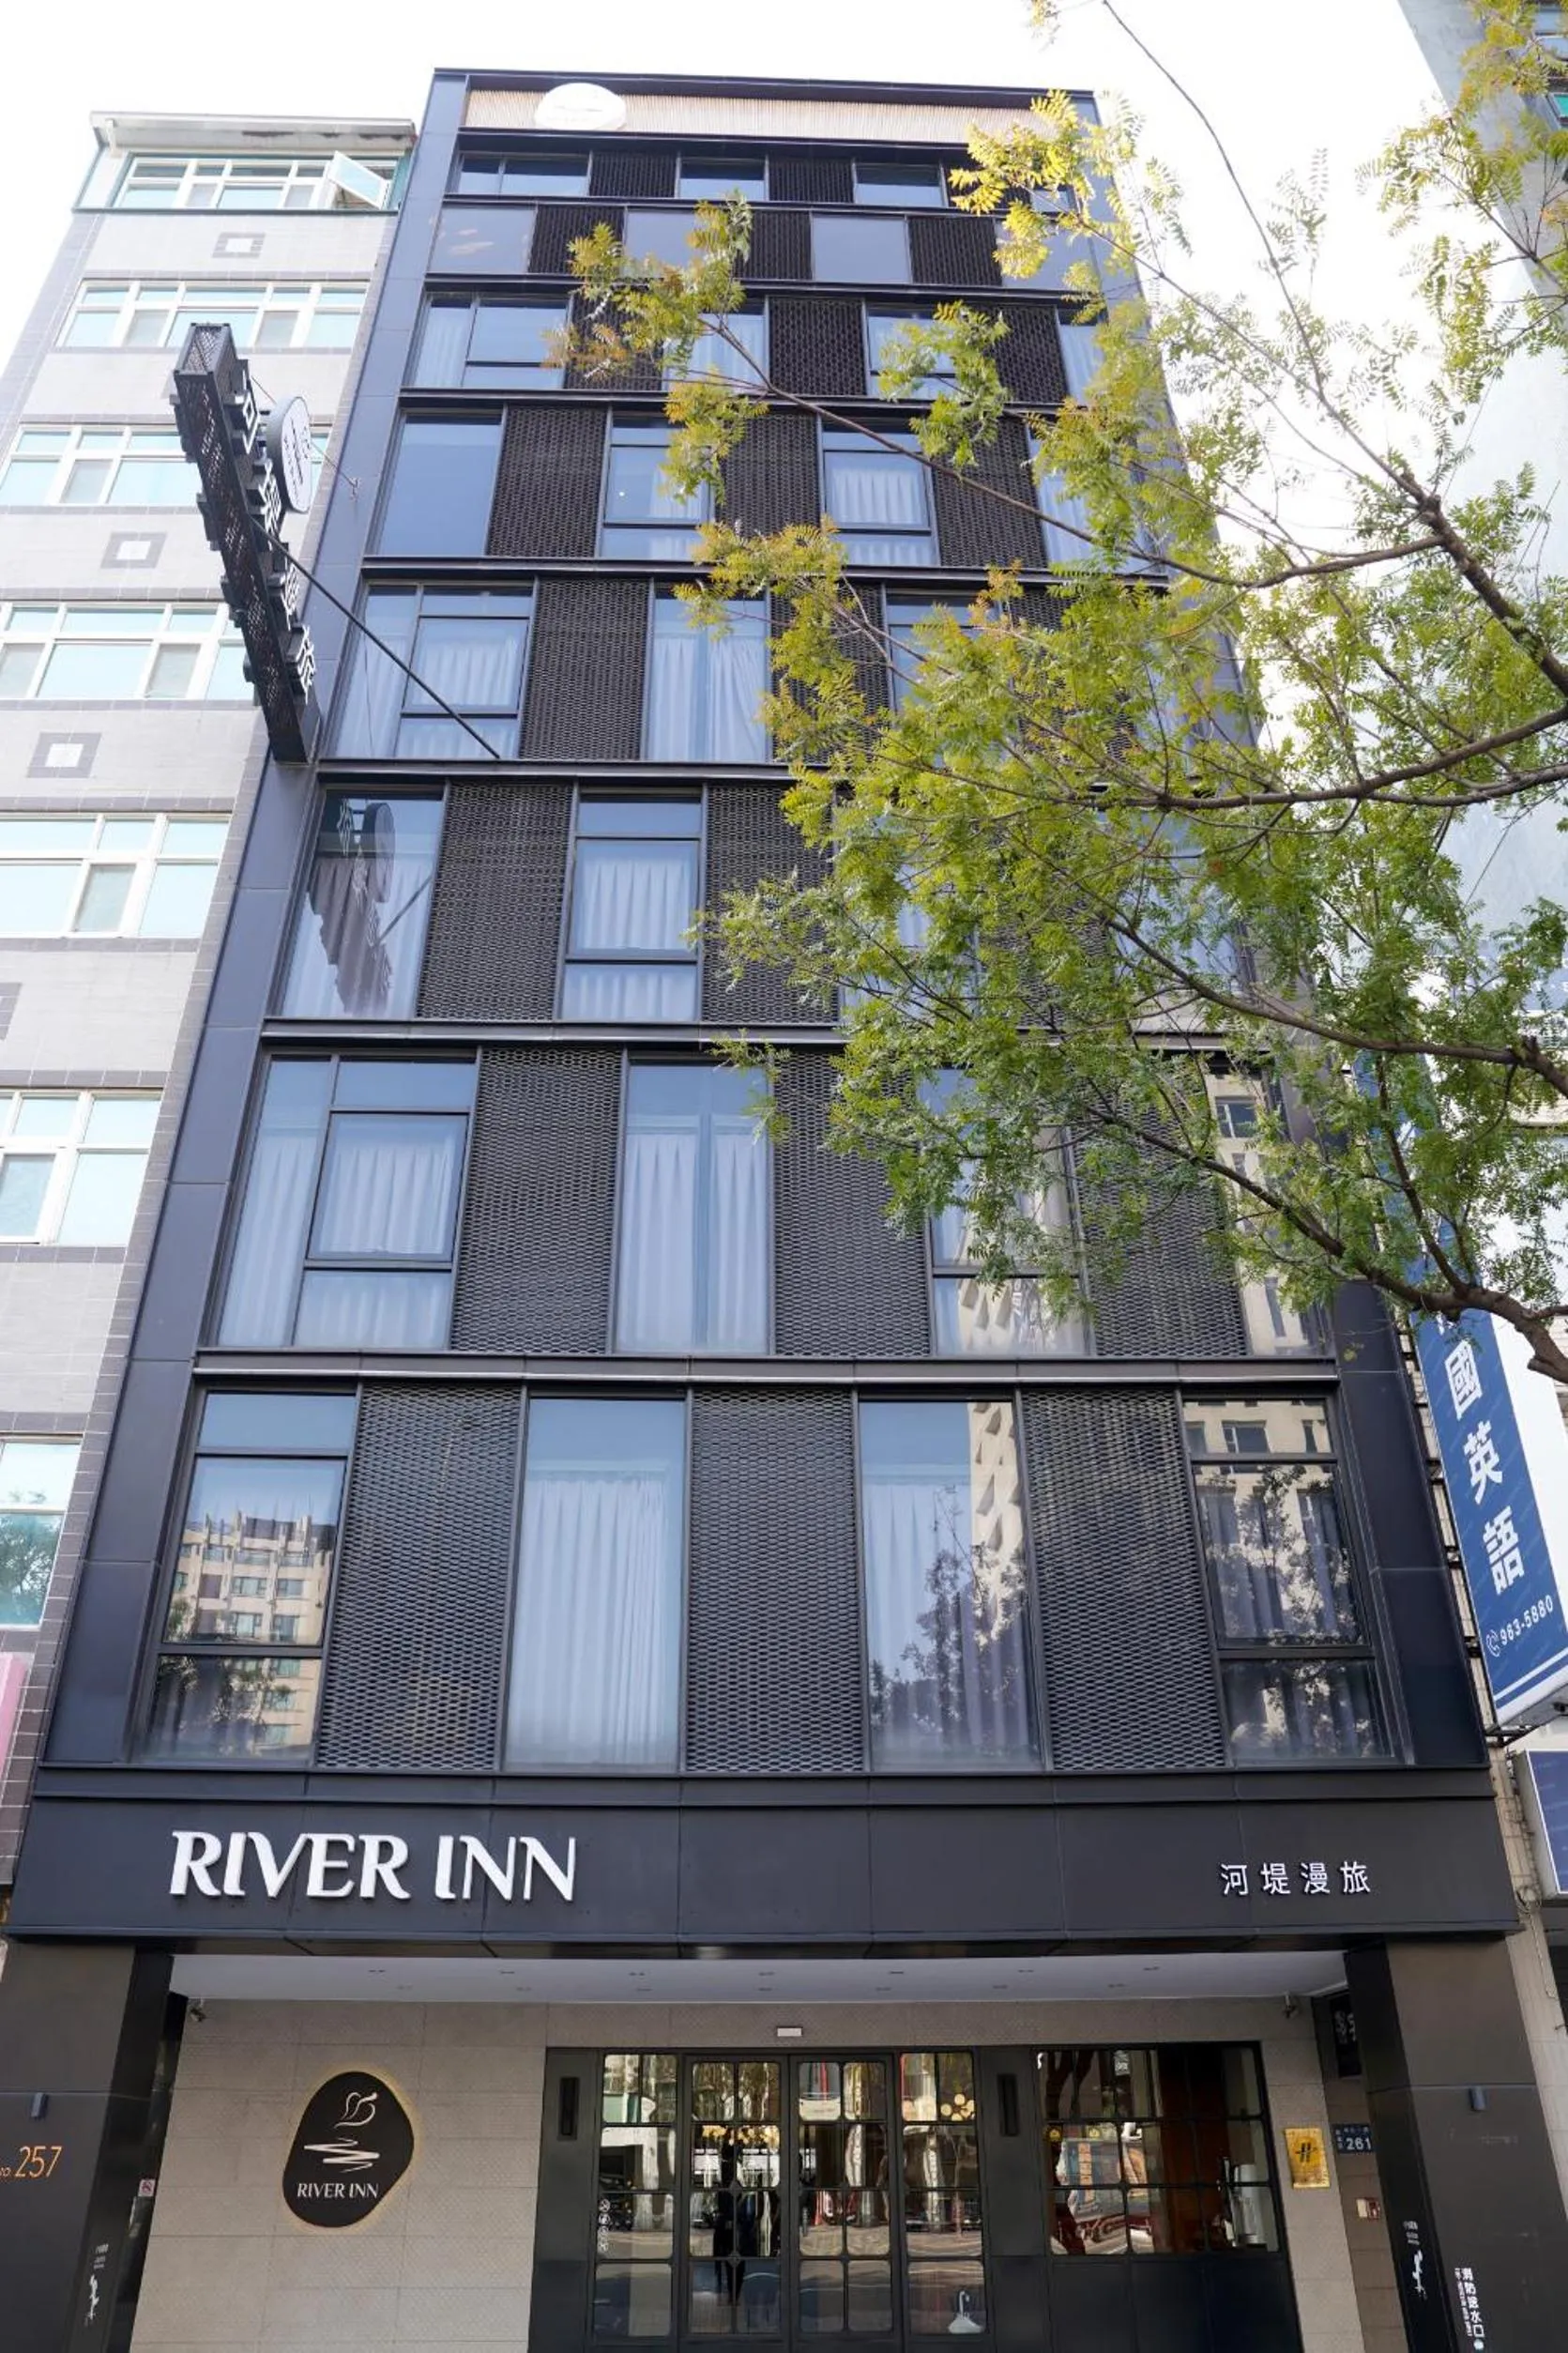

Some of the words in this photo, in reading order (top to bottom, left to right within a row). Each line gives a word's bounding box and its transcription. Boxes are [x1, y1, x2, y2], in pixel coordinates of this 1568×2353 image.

[169, 1829, 412, 1900] RIVER
[434, 1834, 577, 1902] INN
[1220, 1860, 1371, 1896] 河堤漫旅
[1346, 2136, 1372, 2150] 261
[15, 2146, 63, 2178] 257
[297, 2182, 345, 2199] RIVER
[349, 2183, 379, 2199] INN
